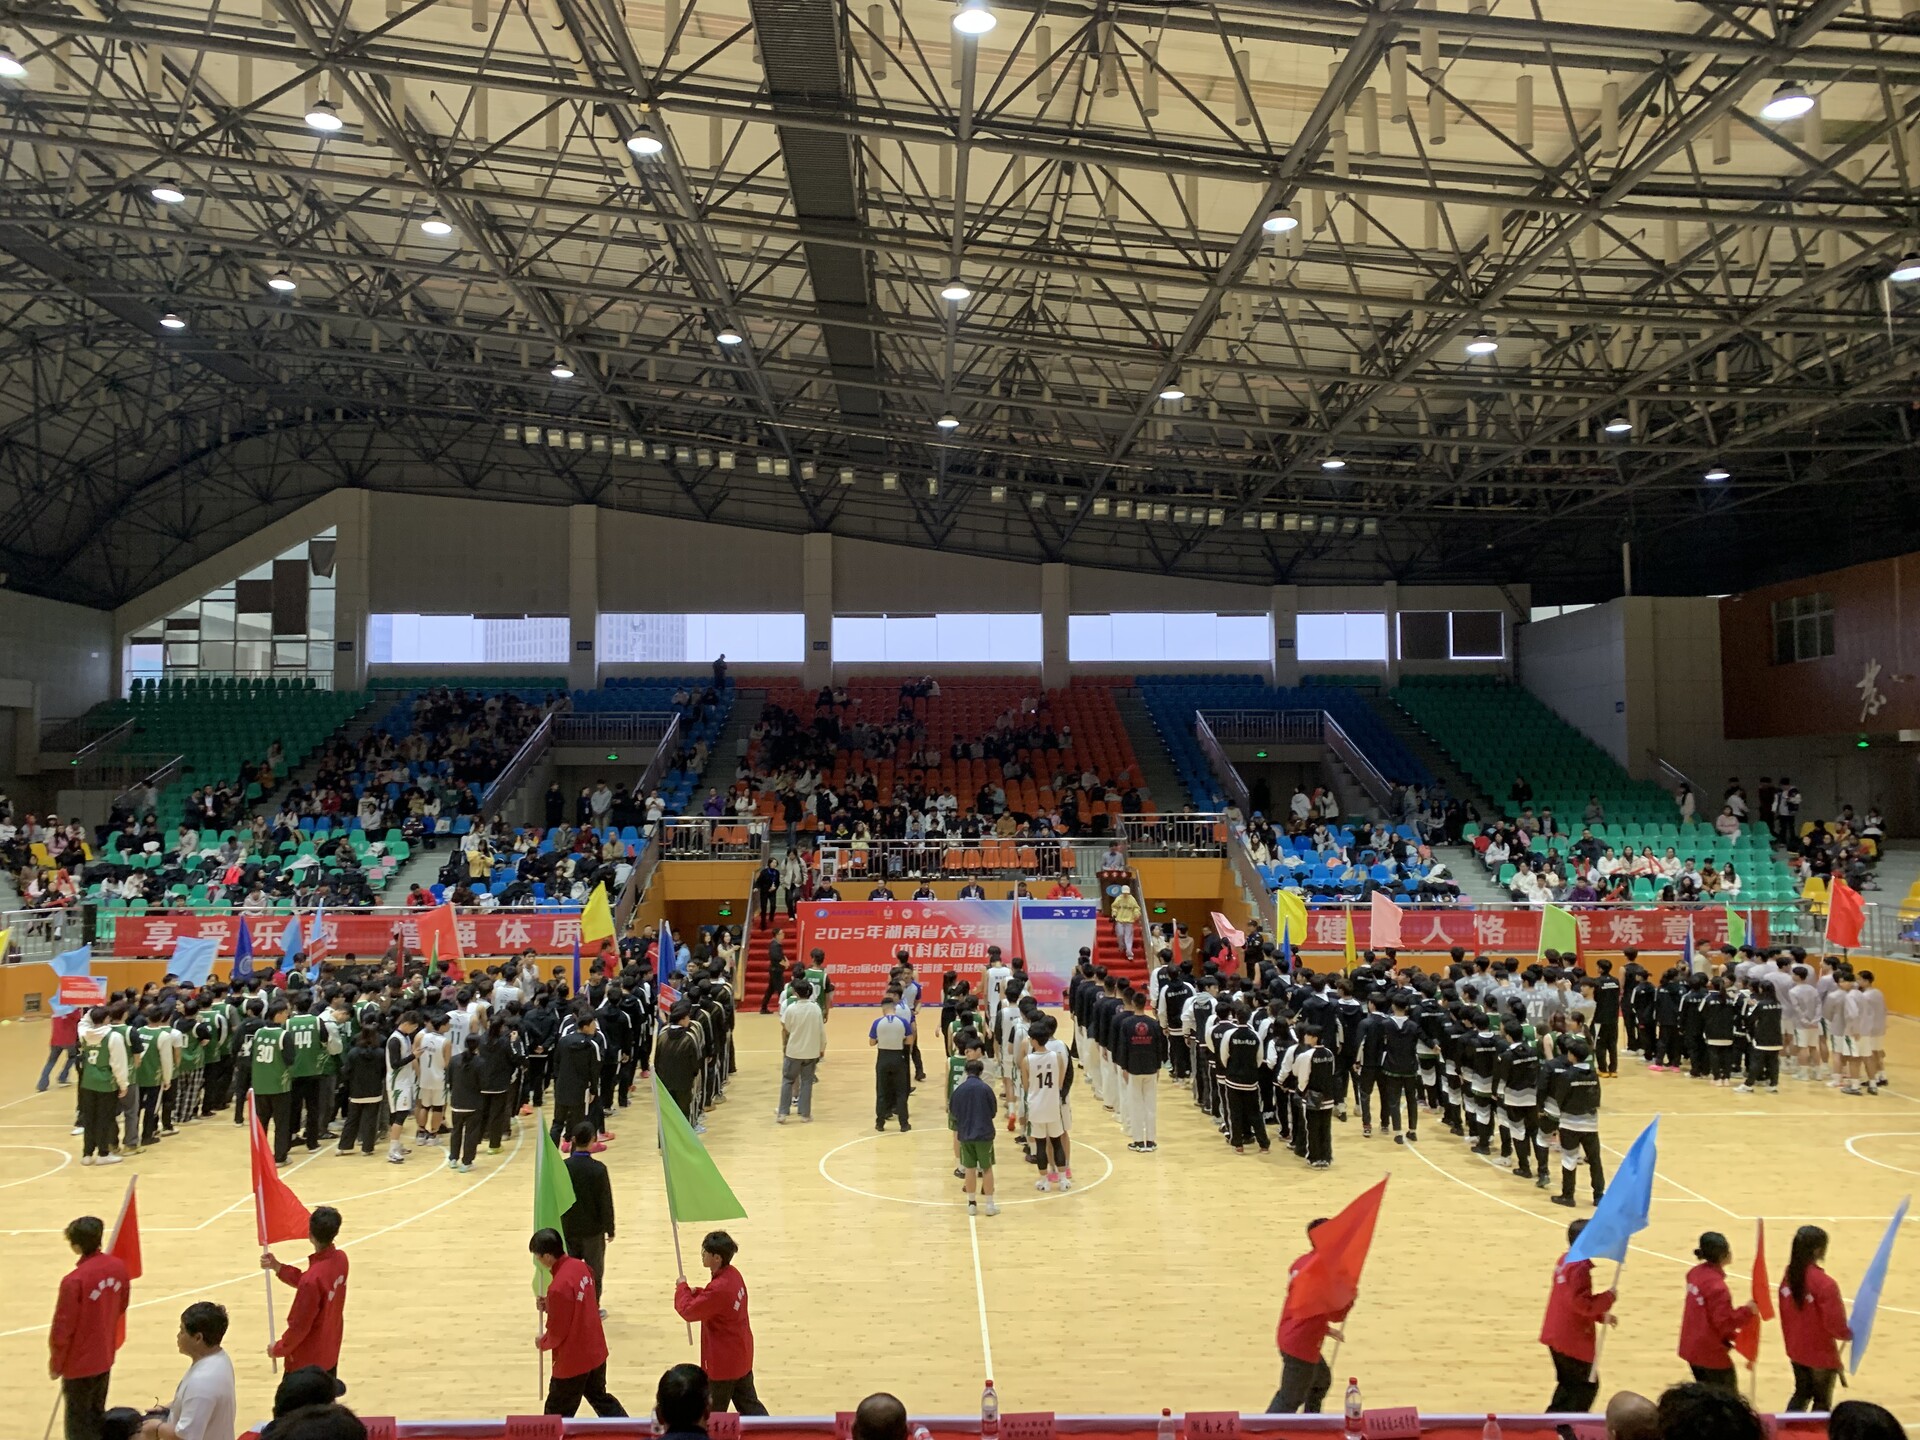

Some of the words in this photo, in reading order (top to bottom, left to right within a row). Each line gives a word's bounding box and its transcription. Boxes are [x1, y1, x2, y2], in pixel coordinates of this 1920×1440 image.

[1314, 915, 1507, 945] 健人格
[1526, 1000, 1544, 1018] 47
[294, 1031, 312, 1049] 44
[256, 1044, 274, 1063] 30
[1036, 1072, 1054, 1089] 14
